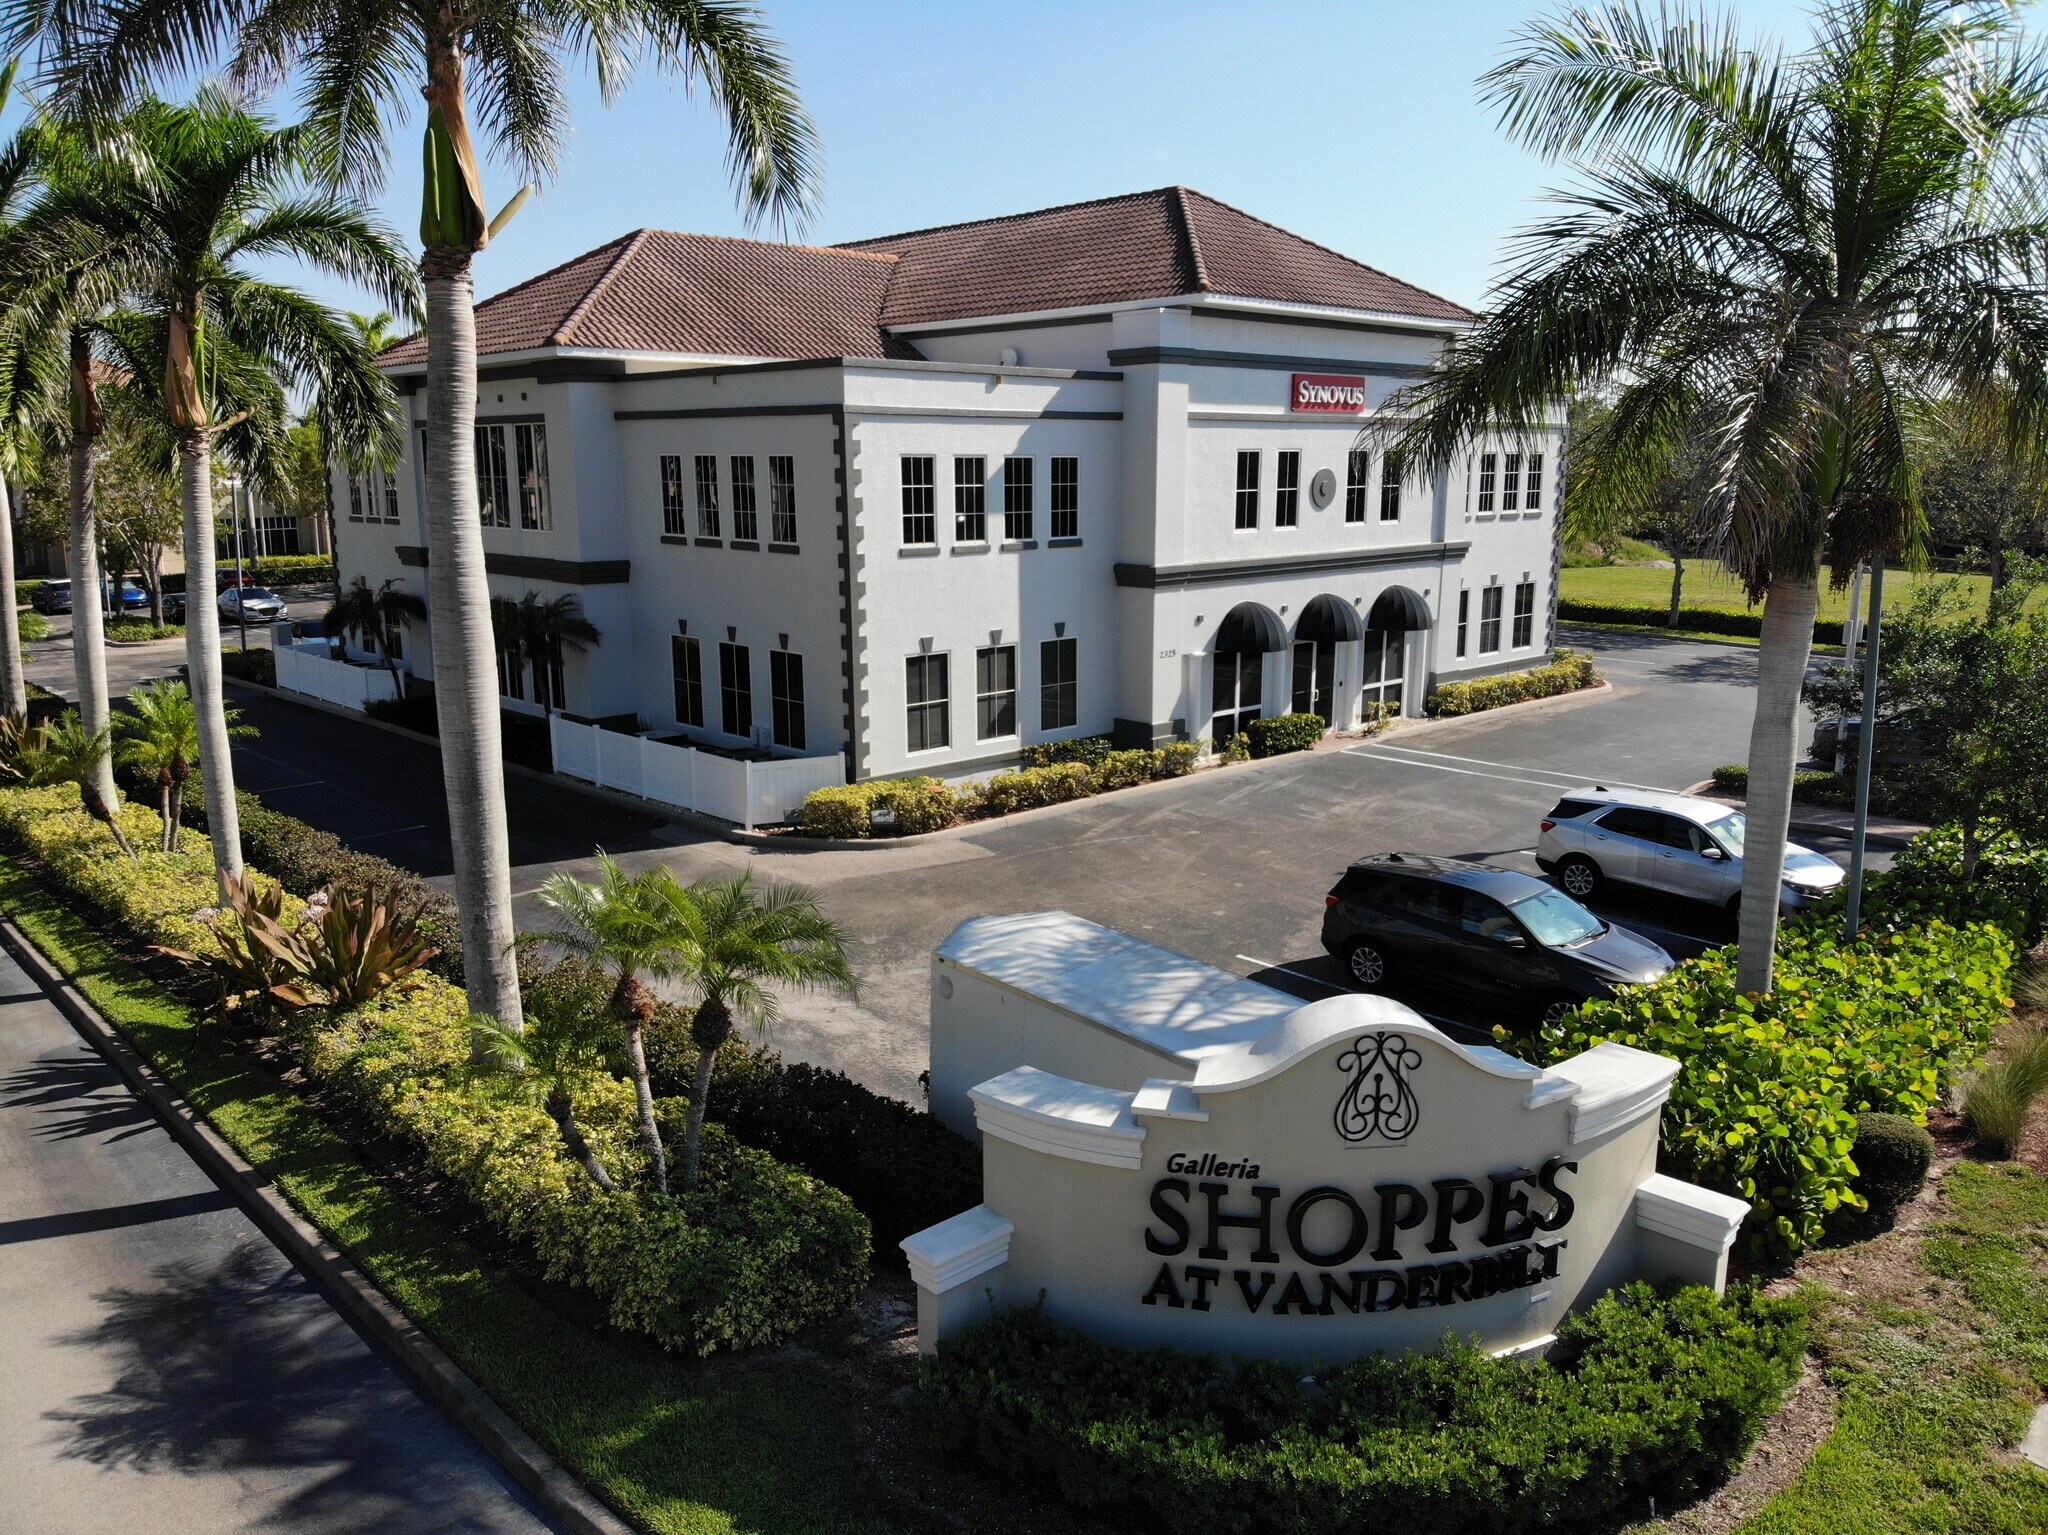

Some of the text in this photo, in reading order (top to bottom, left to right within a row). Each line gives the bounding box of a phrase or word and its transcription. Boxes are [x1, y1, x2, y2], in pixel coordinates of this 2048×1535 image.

[1299, 380, 1364, 404] SYNOVUS
[1160, 649, 1176, 659] 2325
[1167, 1153, 1260, 1180] Galleria
[1144, 1155, 1577, 1267] SHOPPES
[1142, 1236, 1568, 1316] AT VANDERBILT
